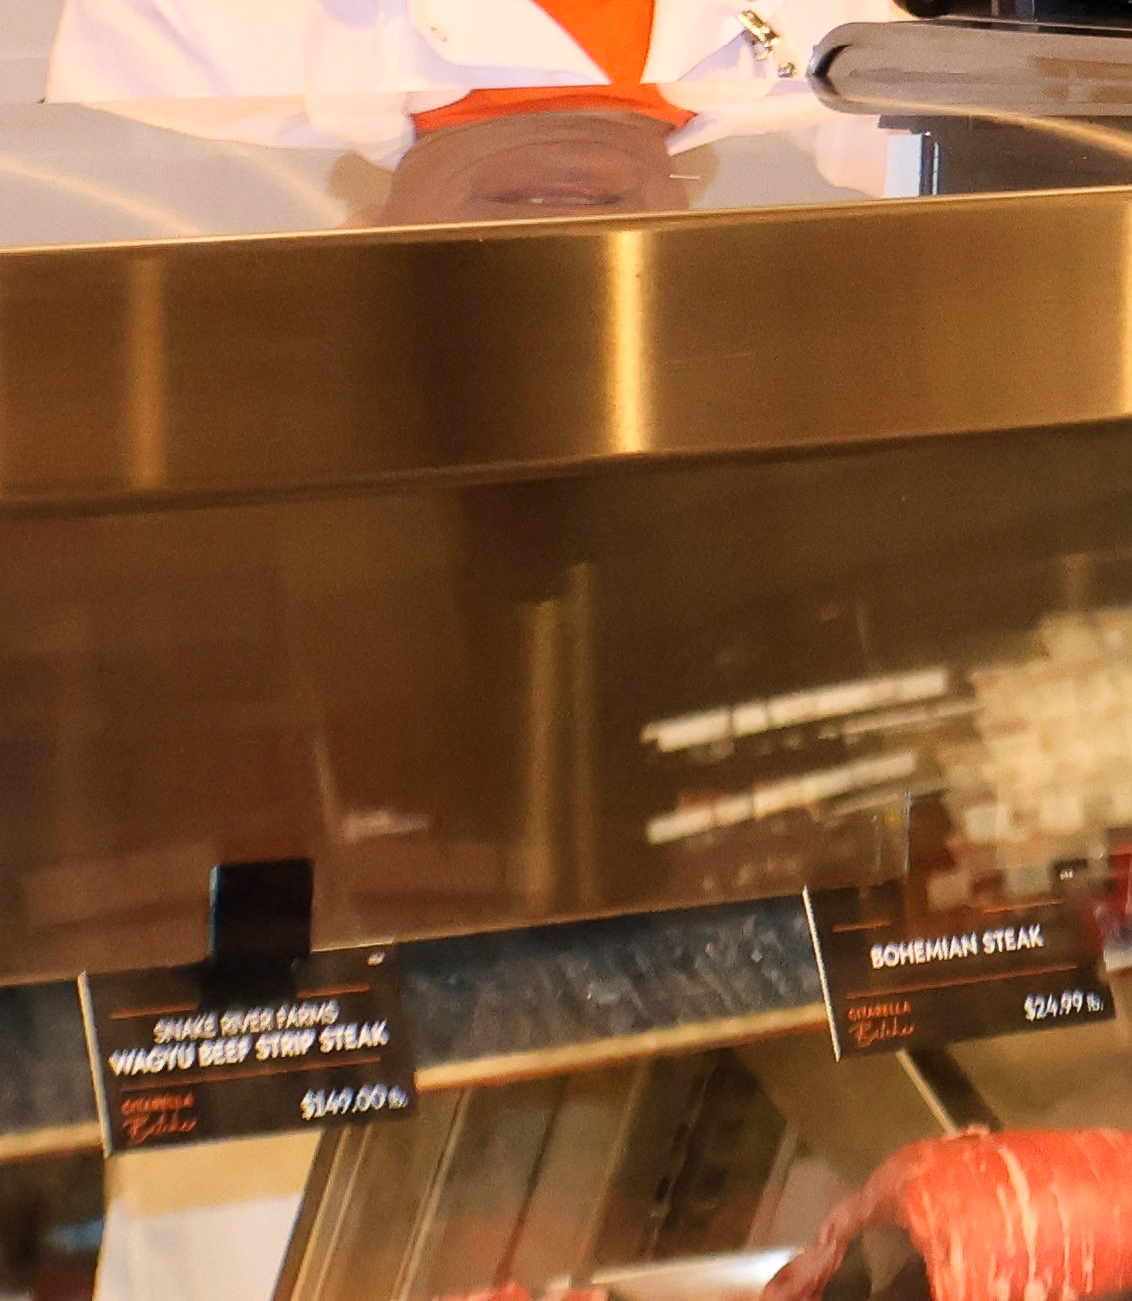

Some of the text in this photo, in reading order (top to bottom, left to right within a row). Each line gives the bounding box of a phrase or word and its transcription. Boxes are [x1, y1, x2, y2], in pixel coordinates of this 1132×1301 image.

[870, 923, 1045, 969] BOHEMIAN STEAK
[153, 1000, 341, 1044] SNAKE RIVER FARMS
[1024, 988, 1084, 1022] $24.99
[108, 1019, 391, 1076] WAGYU BEEF STRIP STEAK
